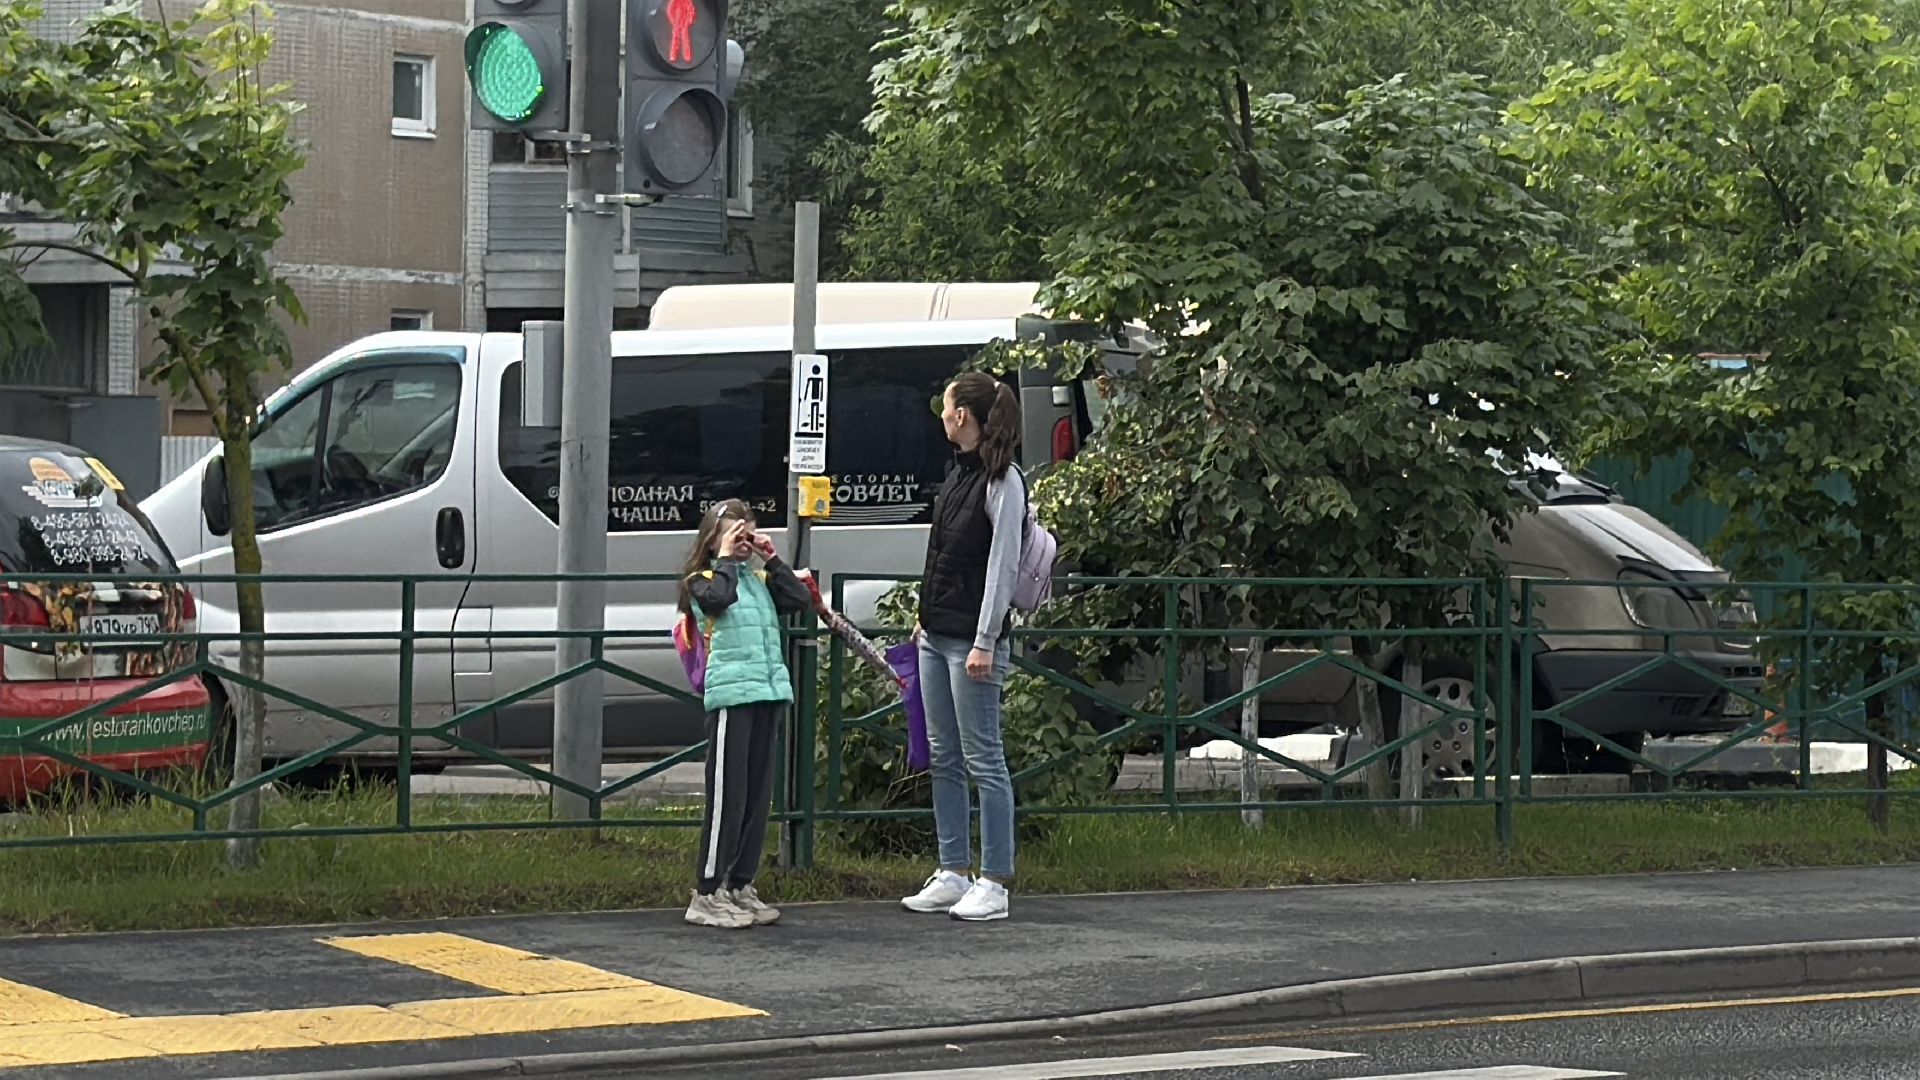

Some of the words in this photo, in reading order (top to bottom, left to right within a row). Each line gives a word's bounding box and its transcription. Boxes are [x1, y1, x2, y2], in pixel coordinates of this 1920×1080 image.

[831, 473, 915, 484] ЕСТОРАН
[830, 483, 920, 503] ОВЧЕГ
[611, 505, 682, 523] ЧАША
